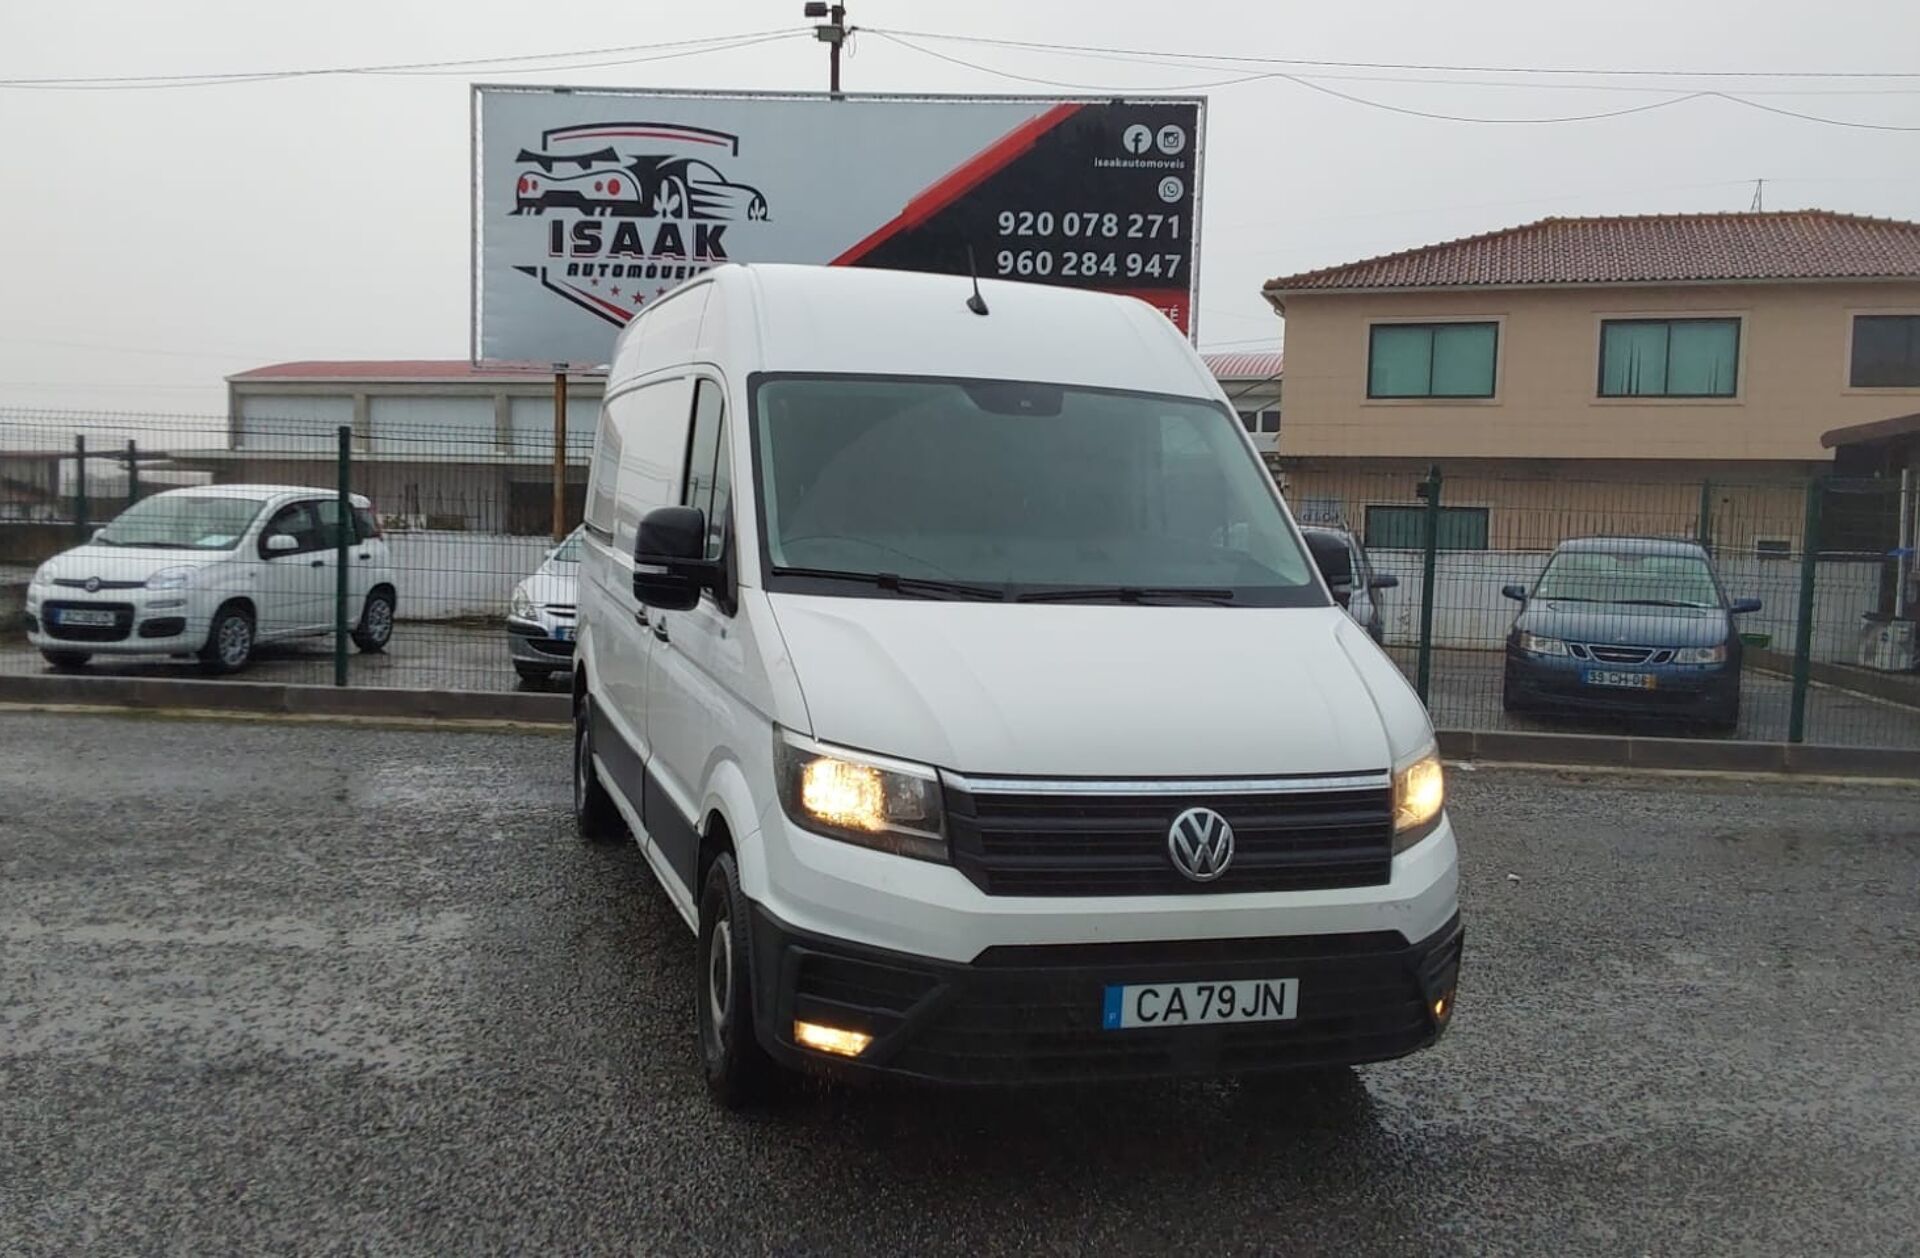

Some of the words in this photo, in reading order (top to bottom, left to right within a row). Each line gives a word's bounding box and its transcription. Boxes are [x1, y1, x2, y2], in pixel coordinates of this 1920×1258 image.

[998, 211, 1054, 236] 920
[1063, 212, 1118, 237] 078
[1127, 214, 1180, 238] 271
[548, 219, 728, 262] ISAAK
[997, 250, 1053, 275] 960
[1061, 251, 1117, 276] 284
[1126, 253, 1181, 278] 947
